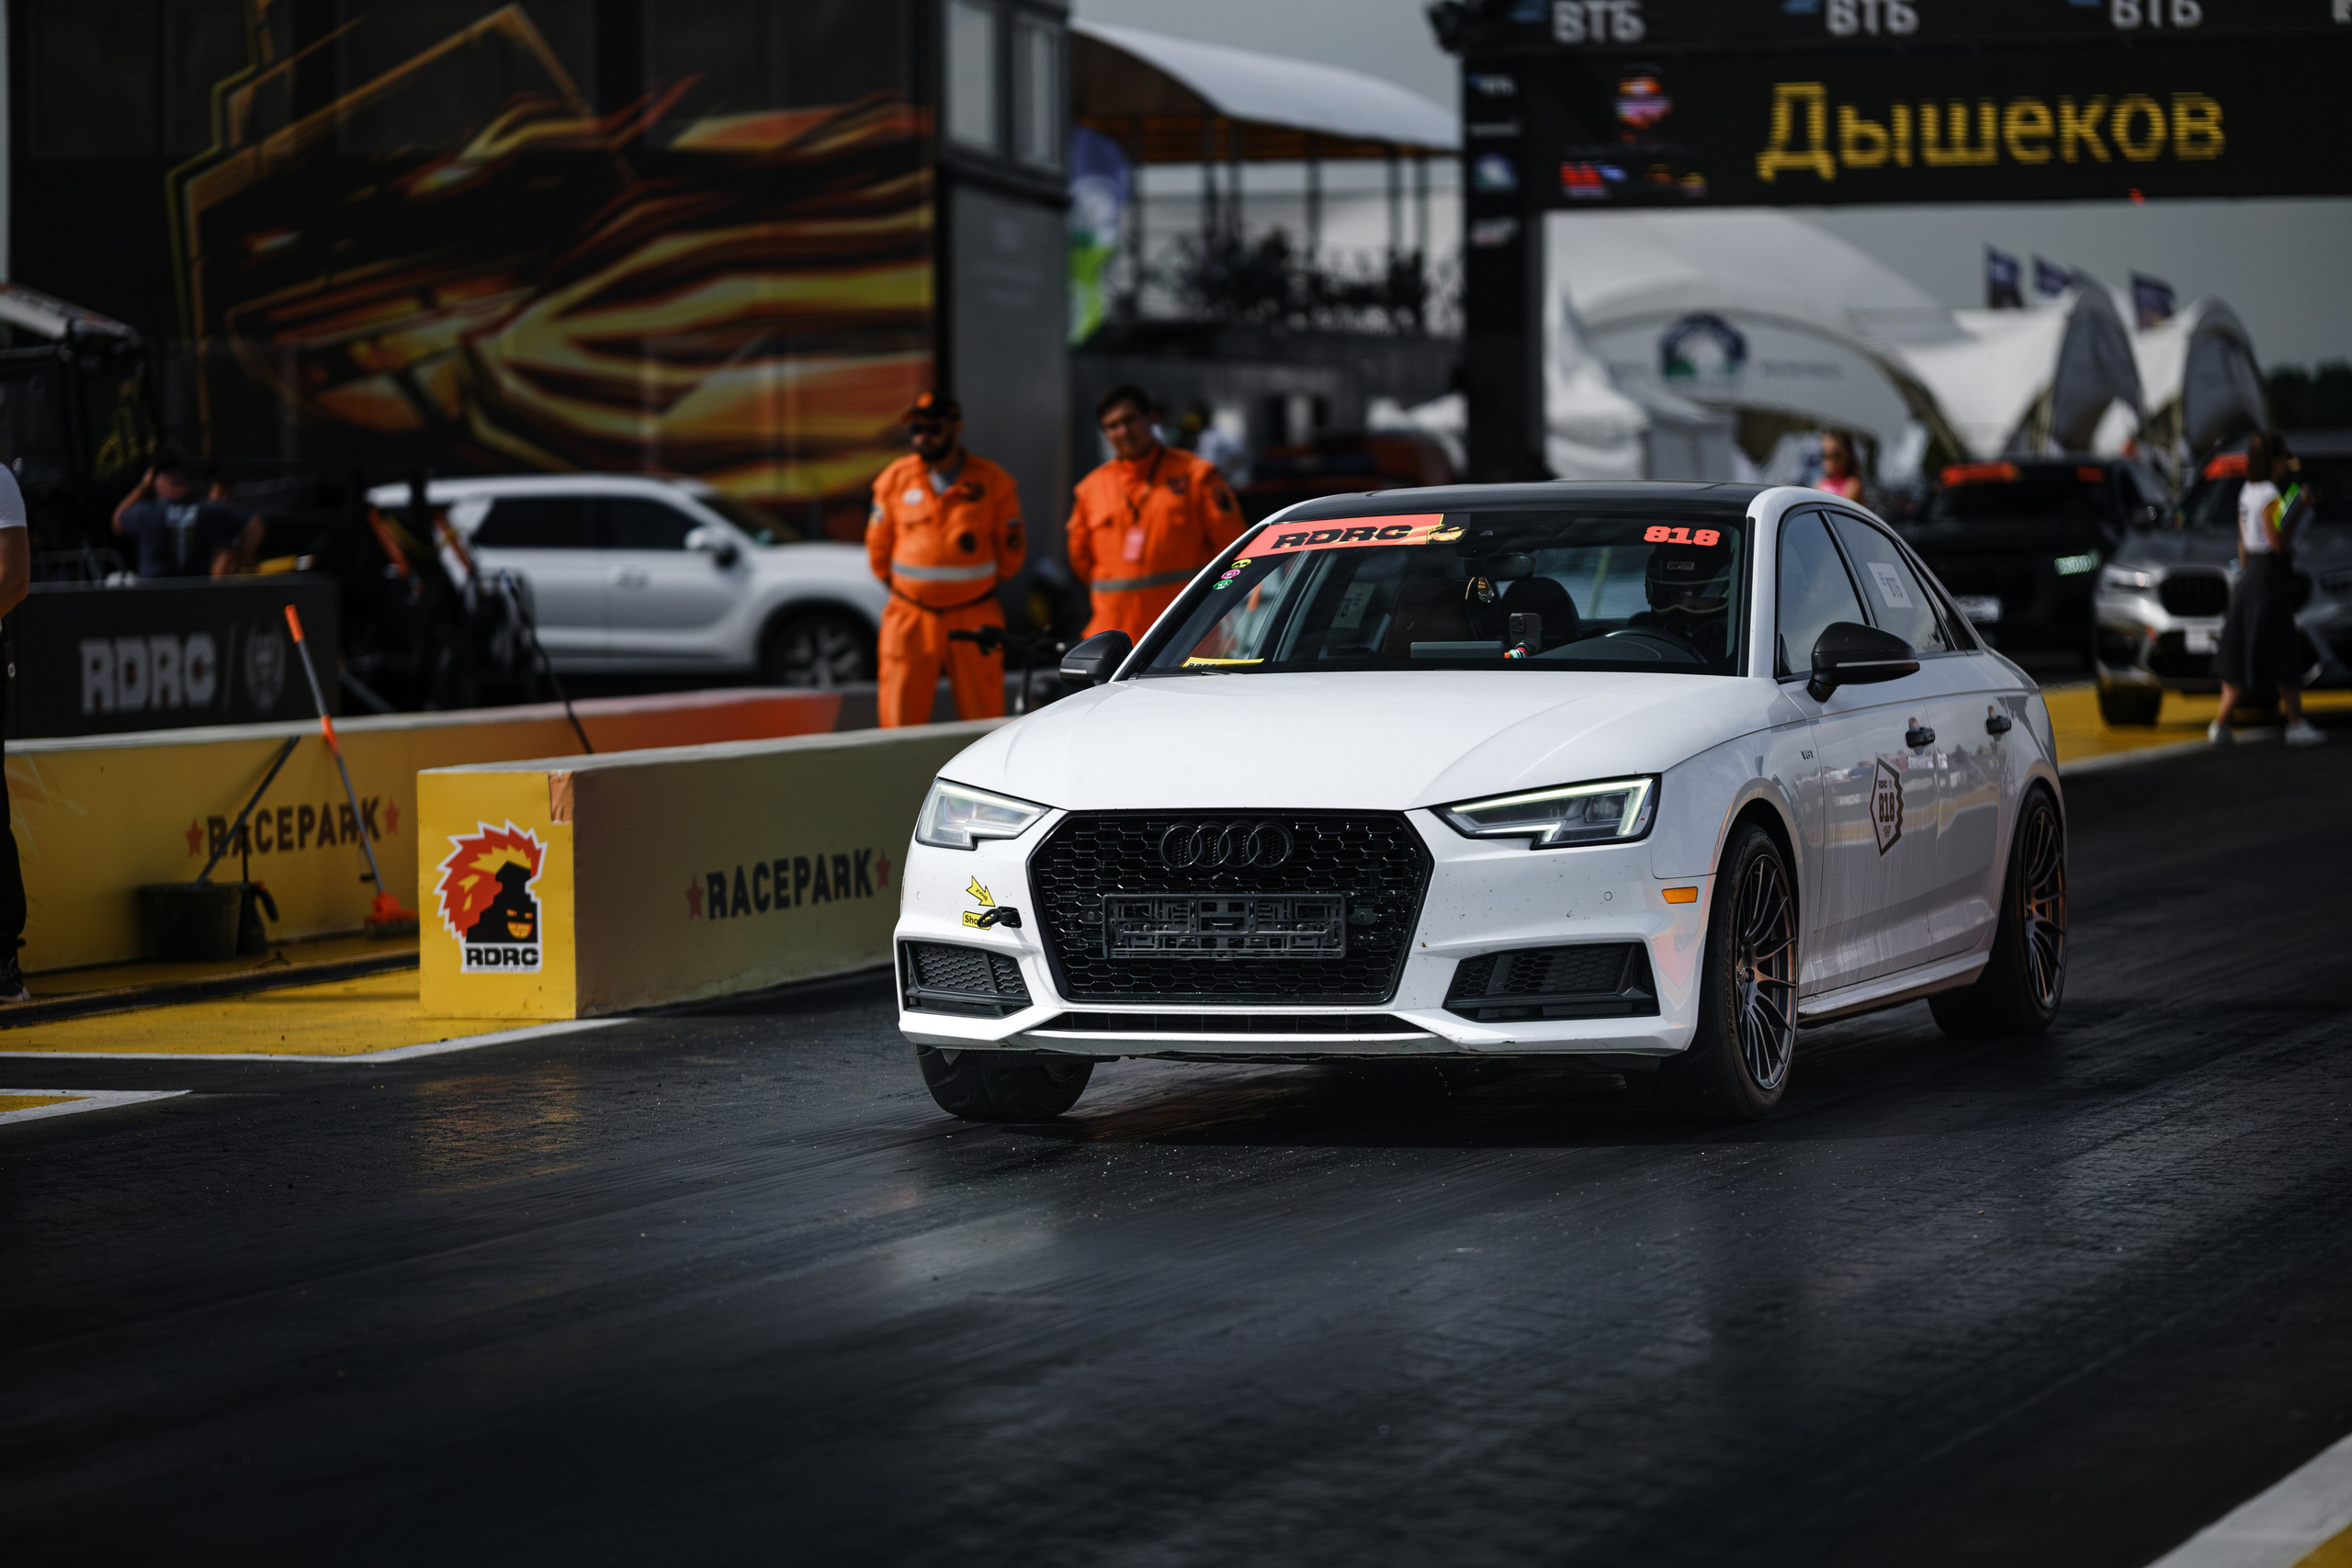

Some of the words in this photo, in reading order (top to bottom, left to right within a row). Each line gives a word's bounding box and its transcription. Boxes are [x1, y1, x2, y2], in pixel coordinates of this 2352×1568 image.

[1756, 81, 2227, 182] Дышеков
[1271, 525, 1413, 550] RDRC
[1644, 525, 1721, 547] 818
[80, 632, 217, 715] RDRC
[1879, 792, 1894, 823] 818
[707, 848, 874, 920] RACEPARK
[466, 947, 539, 966] RDRC
